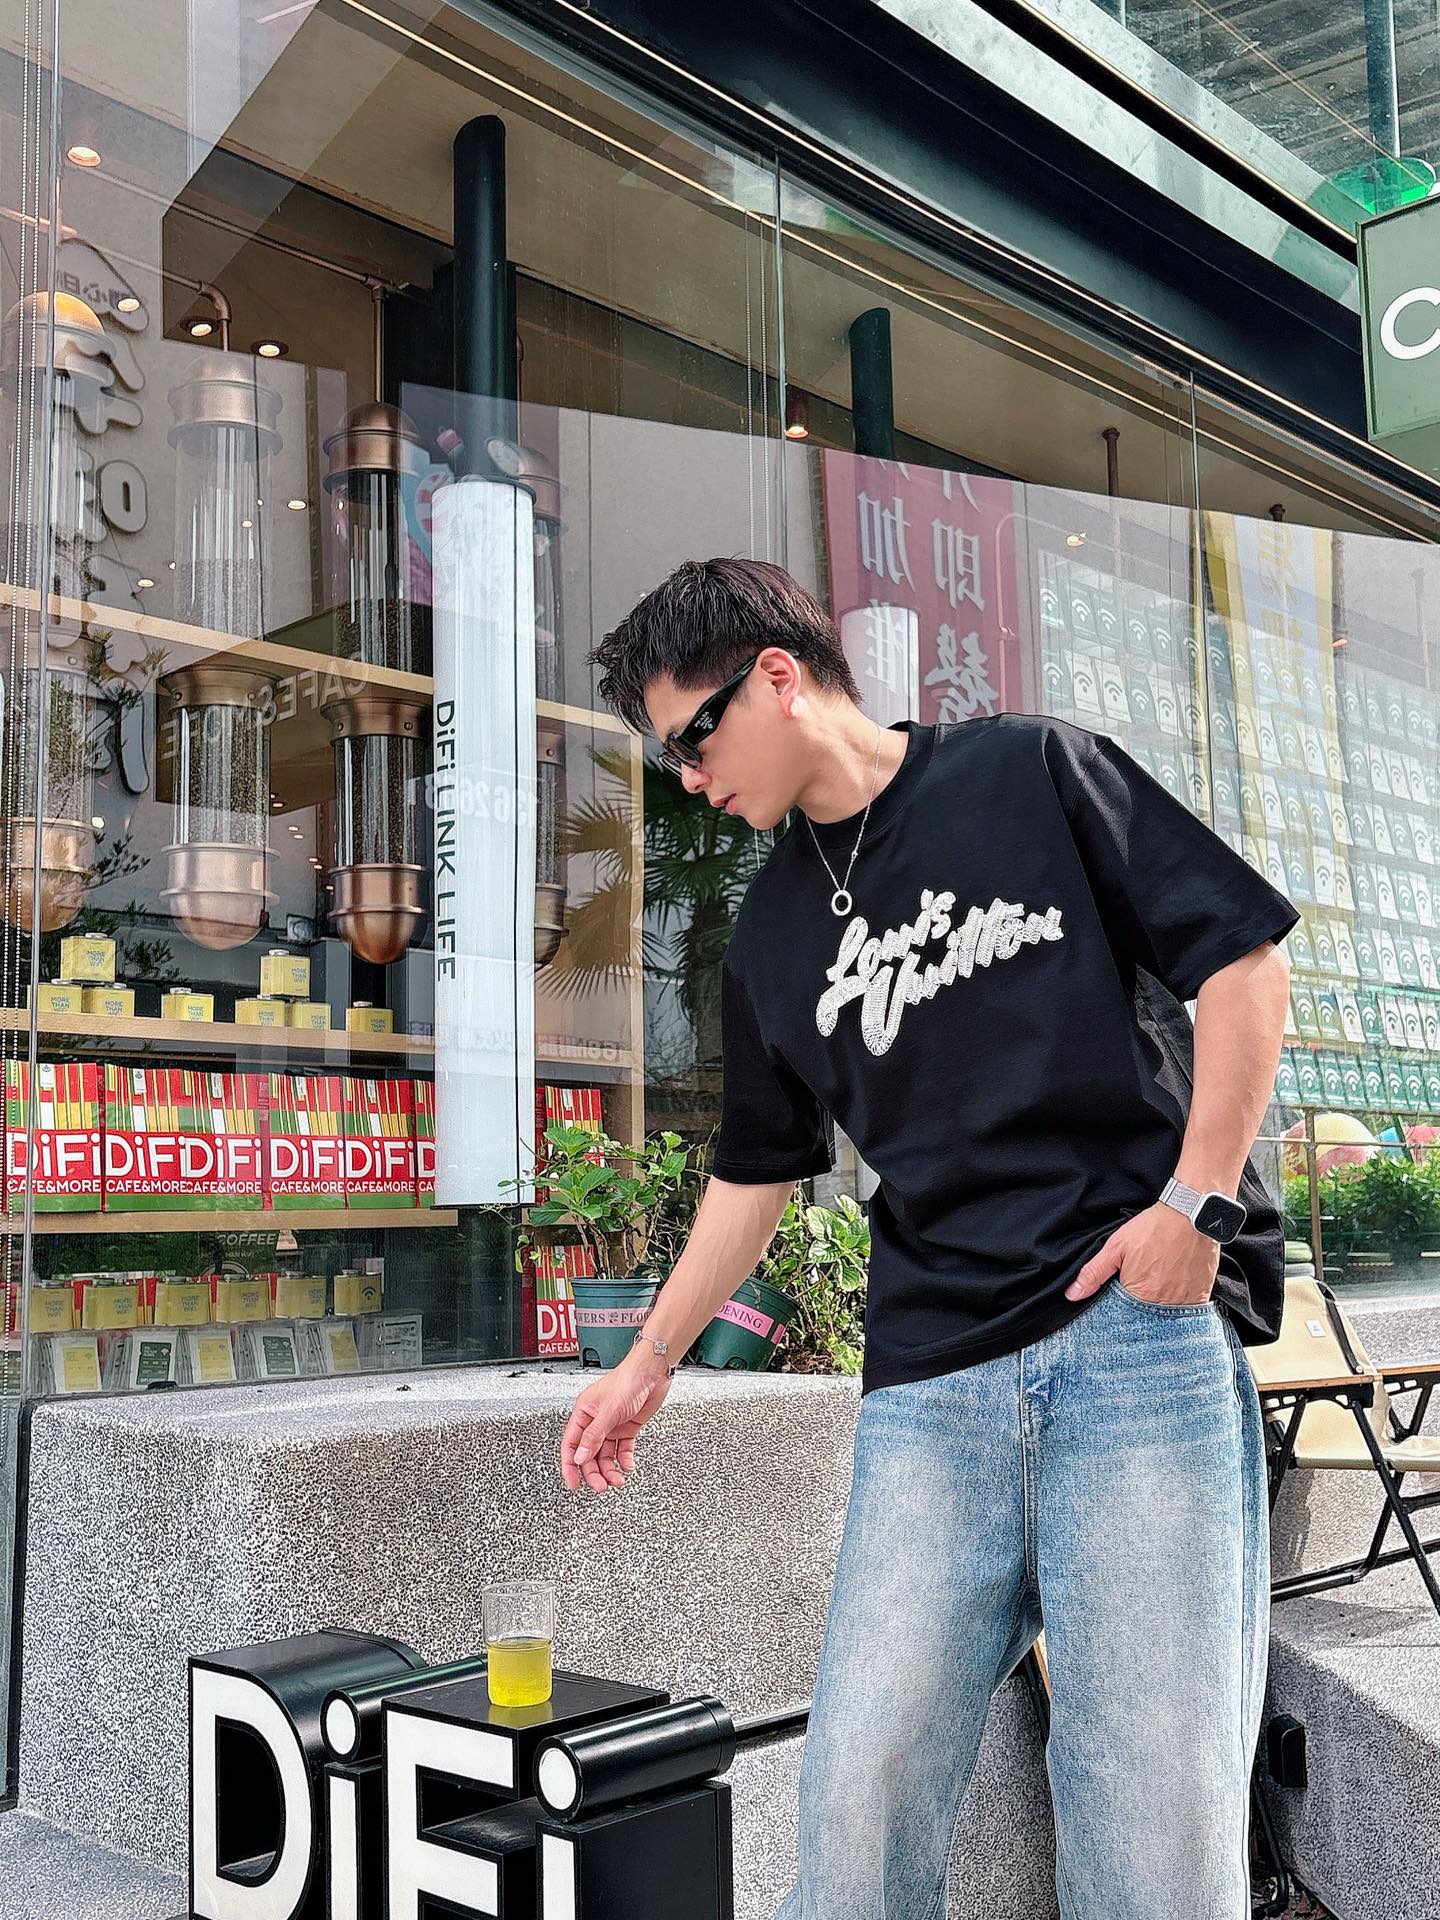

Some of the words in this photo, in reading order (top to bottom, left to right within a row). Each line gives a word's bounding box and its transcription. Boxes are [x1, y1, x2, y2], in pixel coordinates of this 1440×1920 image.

[1380, 286, 1440, 360] C
[437, 701, 455, 771] DiFi
[437, 784, 456, 879] LINK
[437, 891, 456, 981] LIFE
[816, 888, 956, 1037] Louis
[861, 897, 1064, 1056] Vuitton
[7, 1131, 100, 1177] DiFi
[106, 1134, 187, 1178] DiFi
[186, 1137, 262, 1178] DiFi
[271, 1138, 344, 1179] DiFi
[346, 1139, 414, 1178] DiFi
[7, 1179, 100, 1193] CAFE&MORE
[106, 1180, 186, 1194] CAFE&MORE
[271, 1181, 344, 1193] CAFE&MORE
[347, 1181, 415, 1193] CAFE&MORE
[192, 1666, 577, 1920] DiFi
